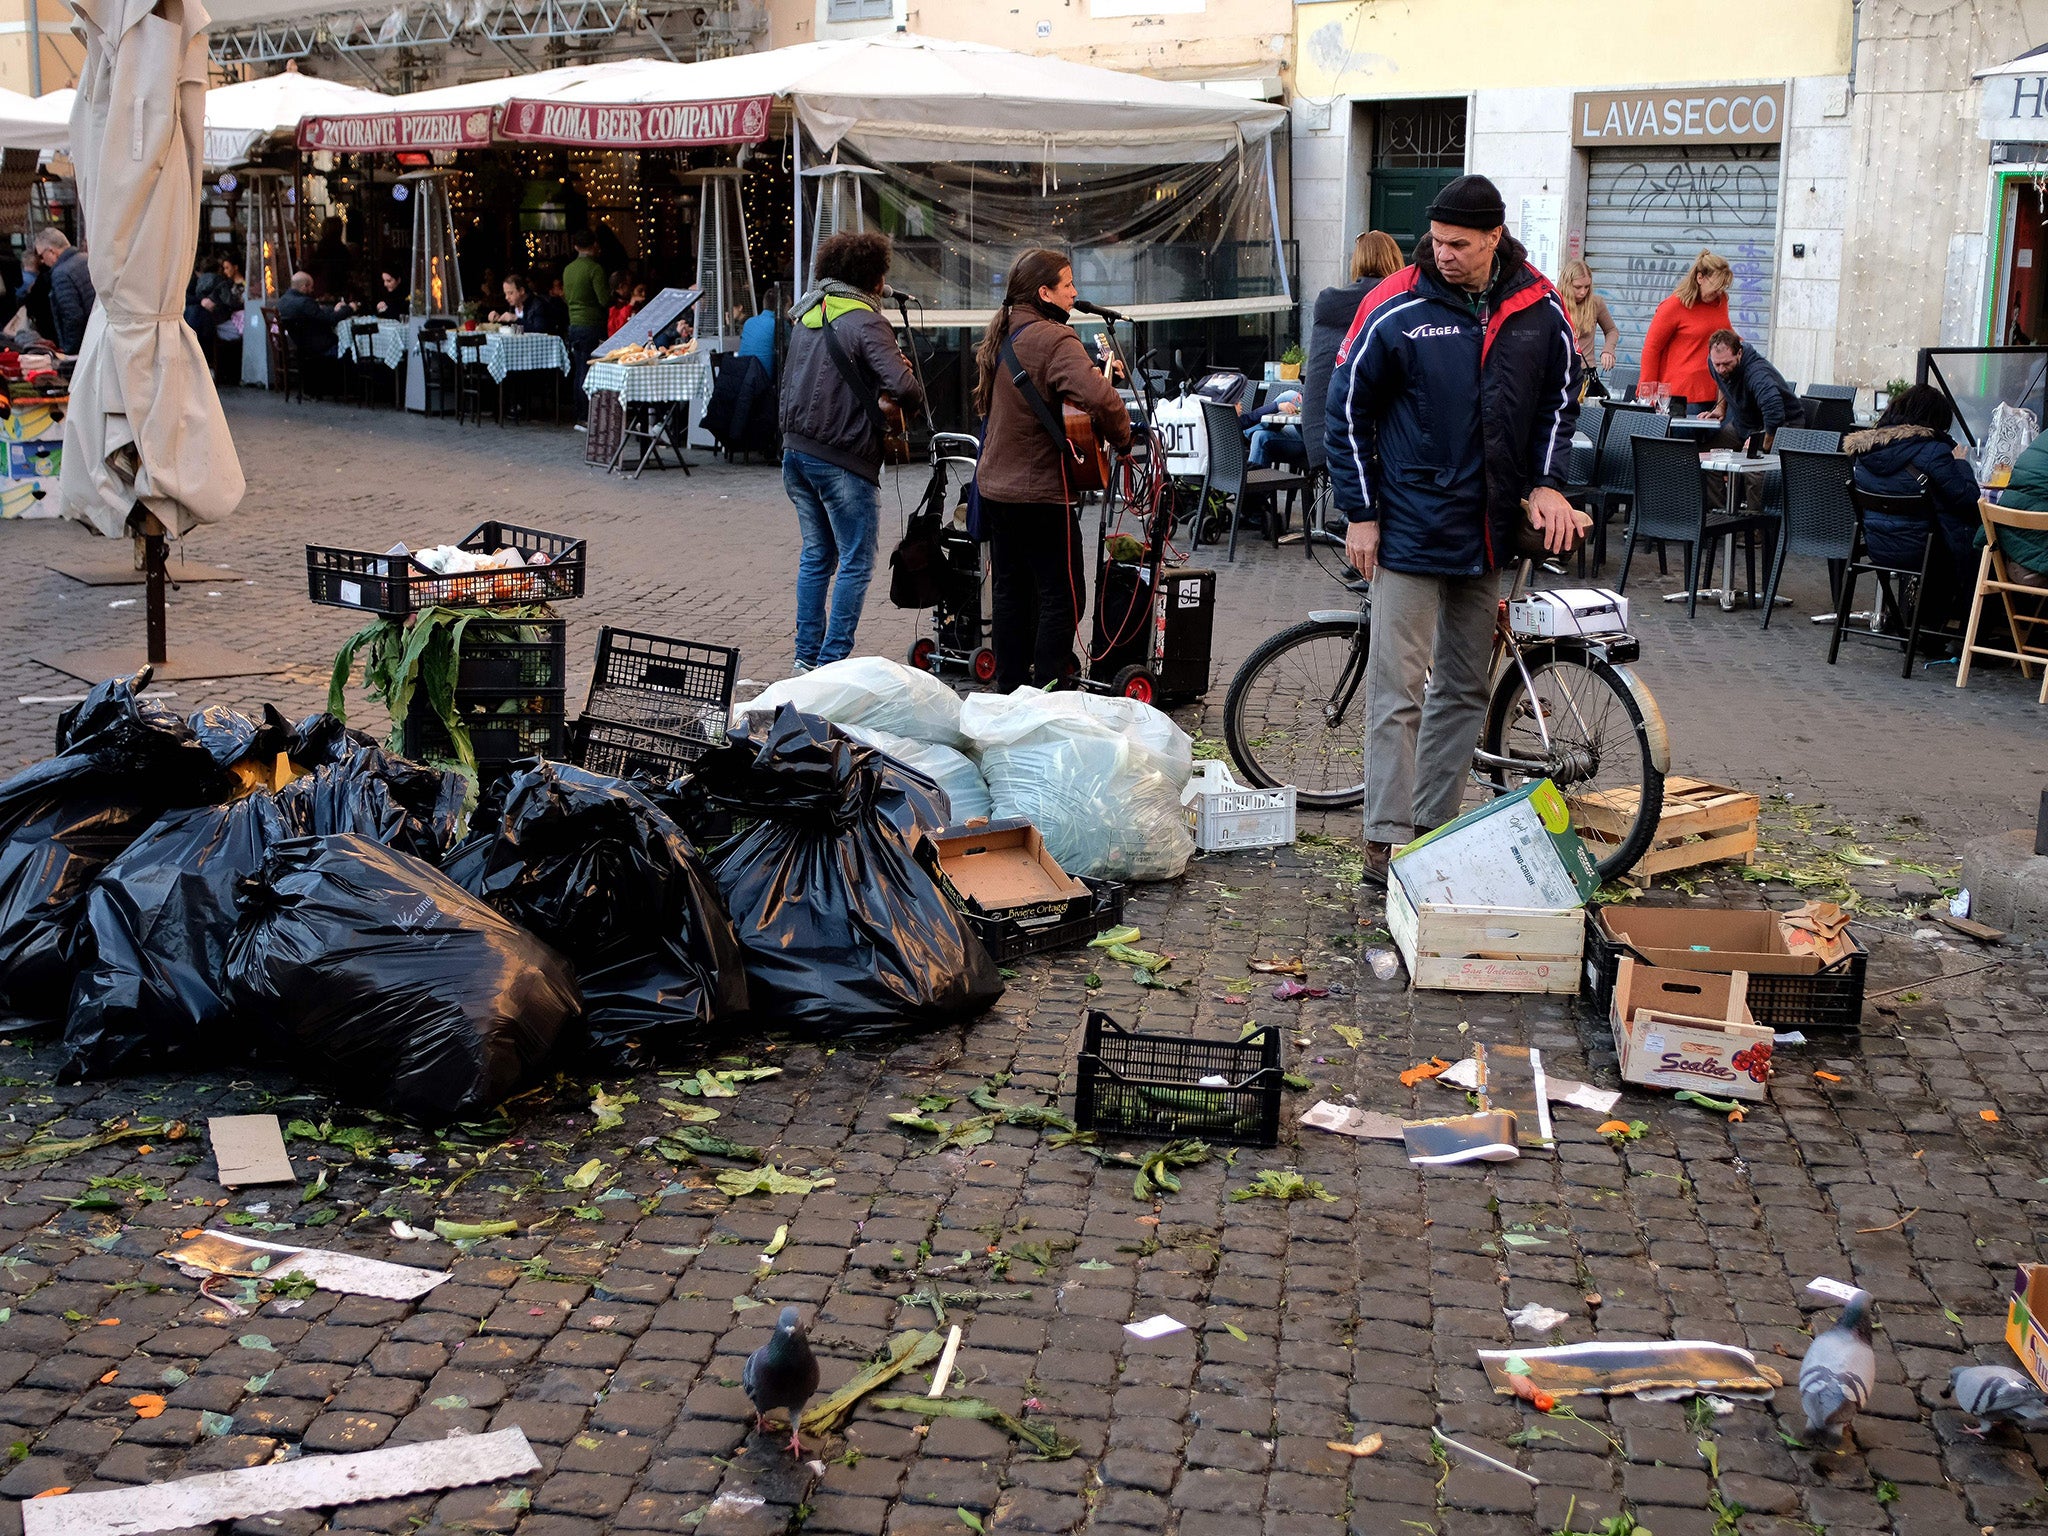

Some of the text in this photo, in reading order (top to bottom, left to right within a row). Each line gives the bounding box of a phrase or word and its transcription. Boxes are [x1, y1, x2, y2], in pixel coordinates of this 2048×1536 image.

[2009, 76, 2048, 118] H
[401, 114, 463, 144] PIZZERIA
[541, 103, 738, 142] ROMA BEER COMPANY
[1582, 95, 1777, 137] LAVASECCO
[1421, 325, 1461, 337] LEGEA
[1461, 963, 1528, 976] San Valentino
[1659, 1053, 1732, 1079] Scalia
